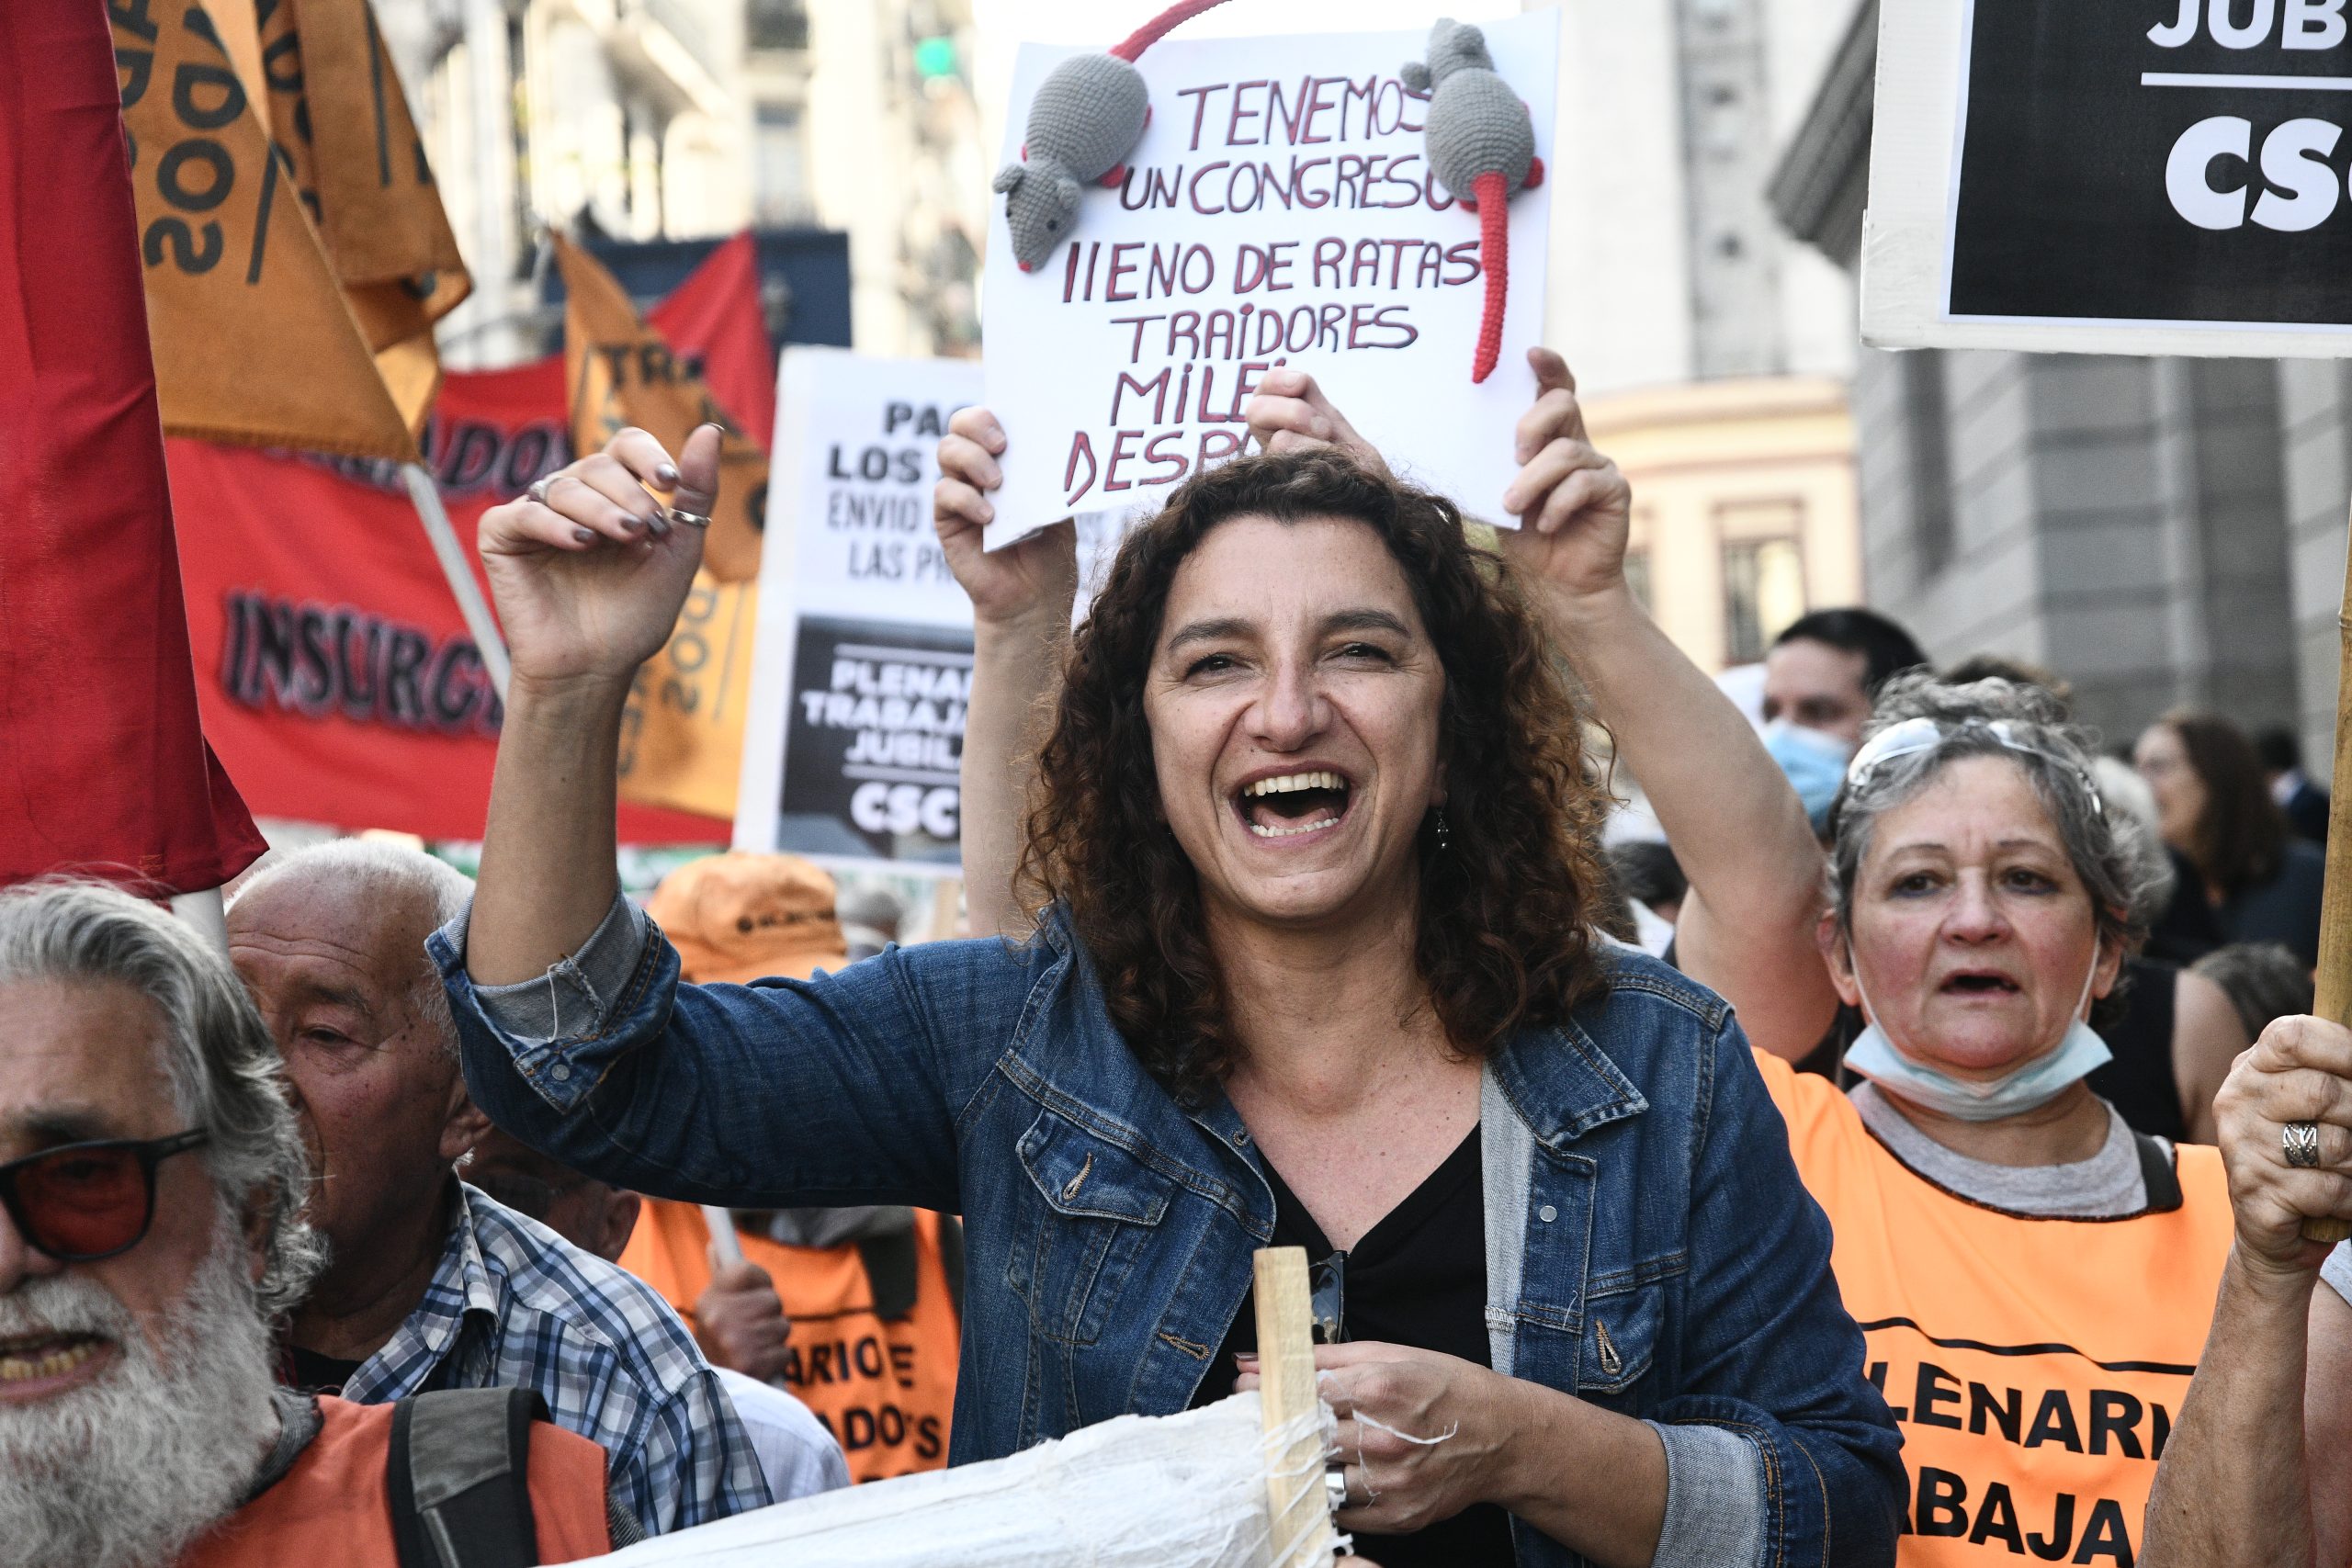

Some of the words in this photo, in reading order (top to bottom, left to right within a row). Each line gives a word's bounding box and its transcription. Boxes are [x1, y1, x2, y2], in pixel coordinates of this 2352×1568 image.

[2165, 116, 2352, 232] CS
[1234, 241, 1301, 295] DE
[1313, 236, 1481, 289] RATAS
[884, 400, 976, 438] PA
[828, 445, 922, 485] LOS
[1064, 430, 1253, 507] DESP
[847, 540, 904, 579] LAS
[831, 659, 973, 699] PLENA
[850, 781, 960, 839] CSC
[1898, 1466, 2149, 1568] BAJA
